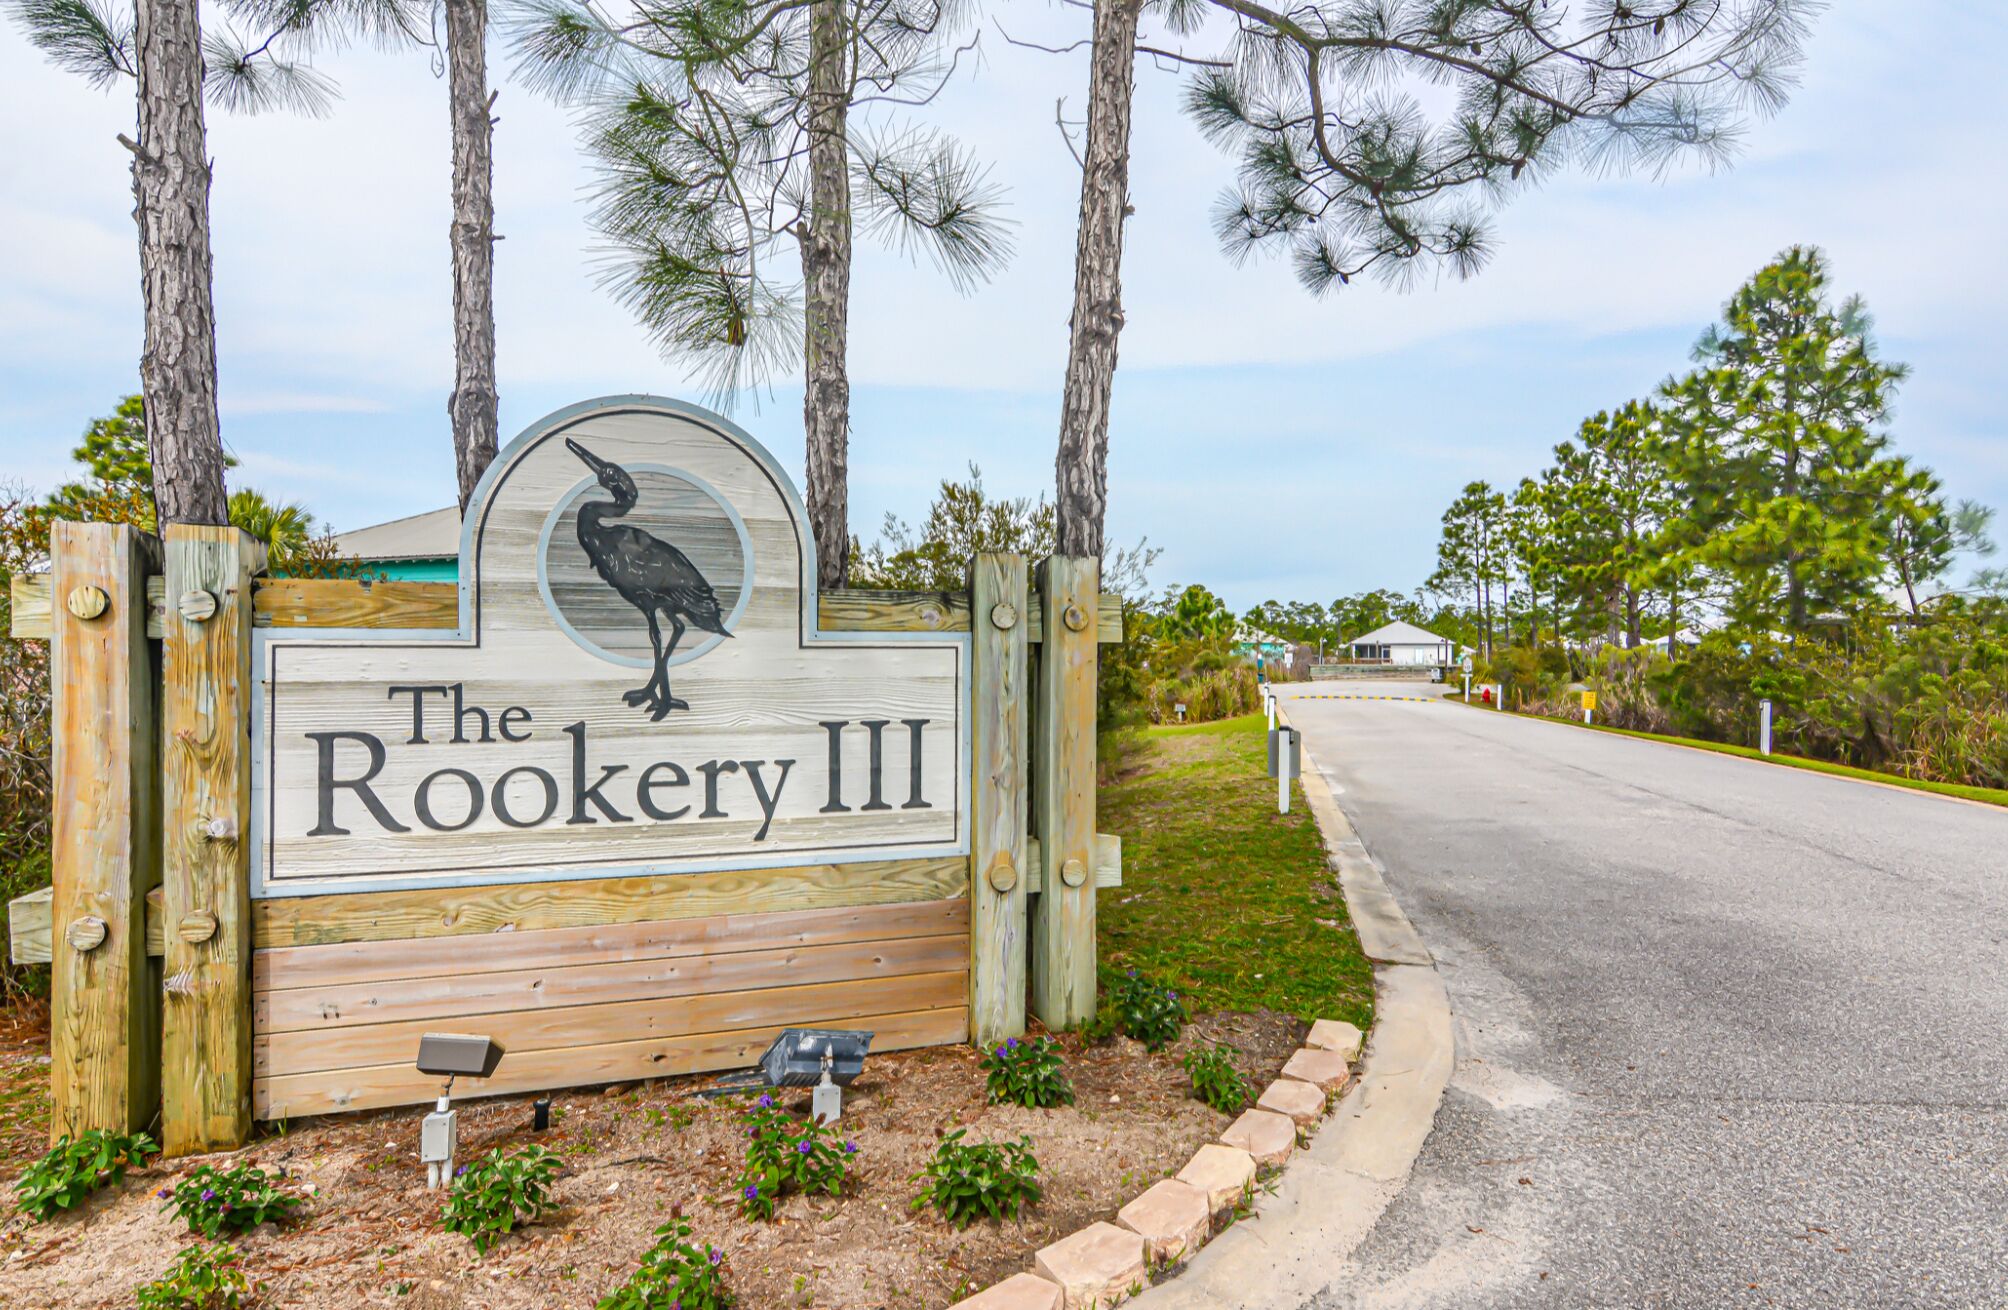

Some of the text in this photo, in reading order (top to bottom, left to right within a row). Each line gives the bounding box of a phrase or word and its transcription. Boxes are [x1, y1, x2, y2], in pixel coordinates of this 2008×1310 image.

[388, 683, 533, 745] The
[305, 719, 934, 842] Rookery III
